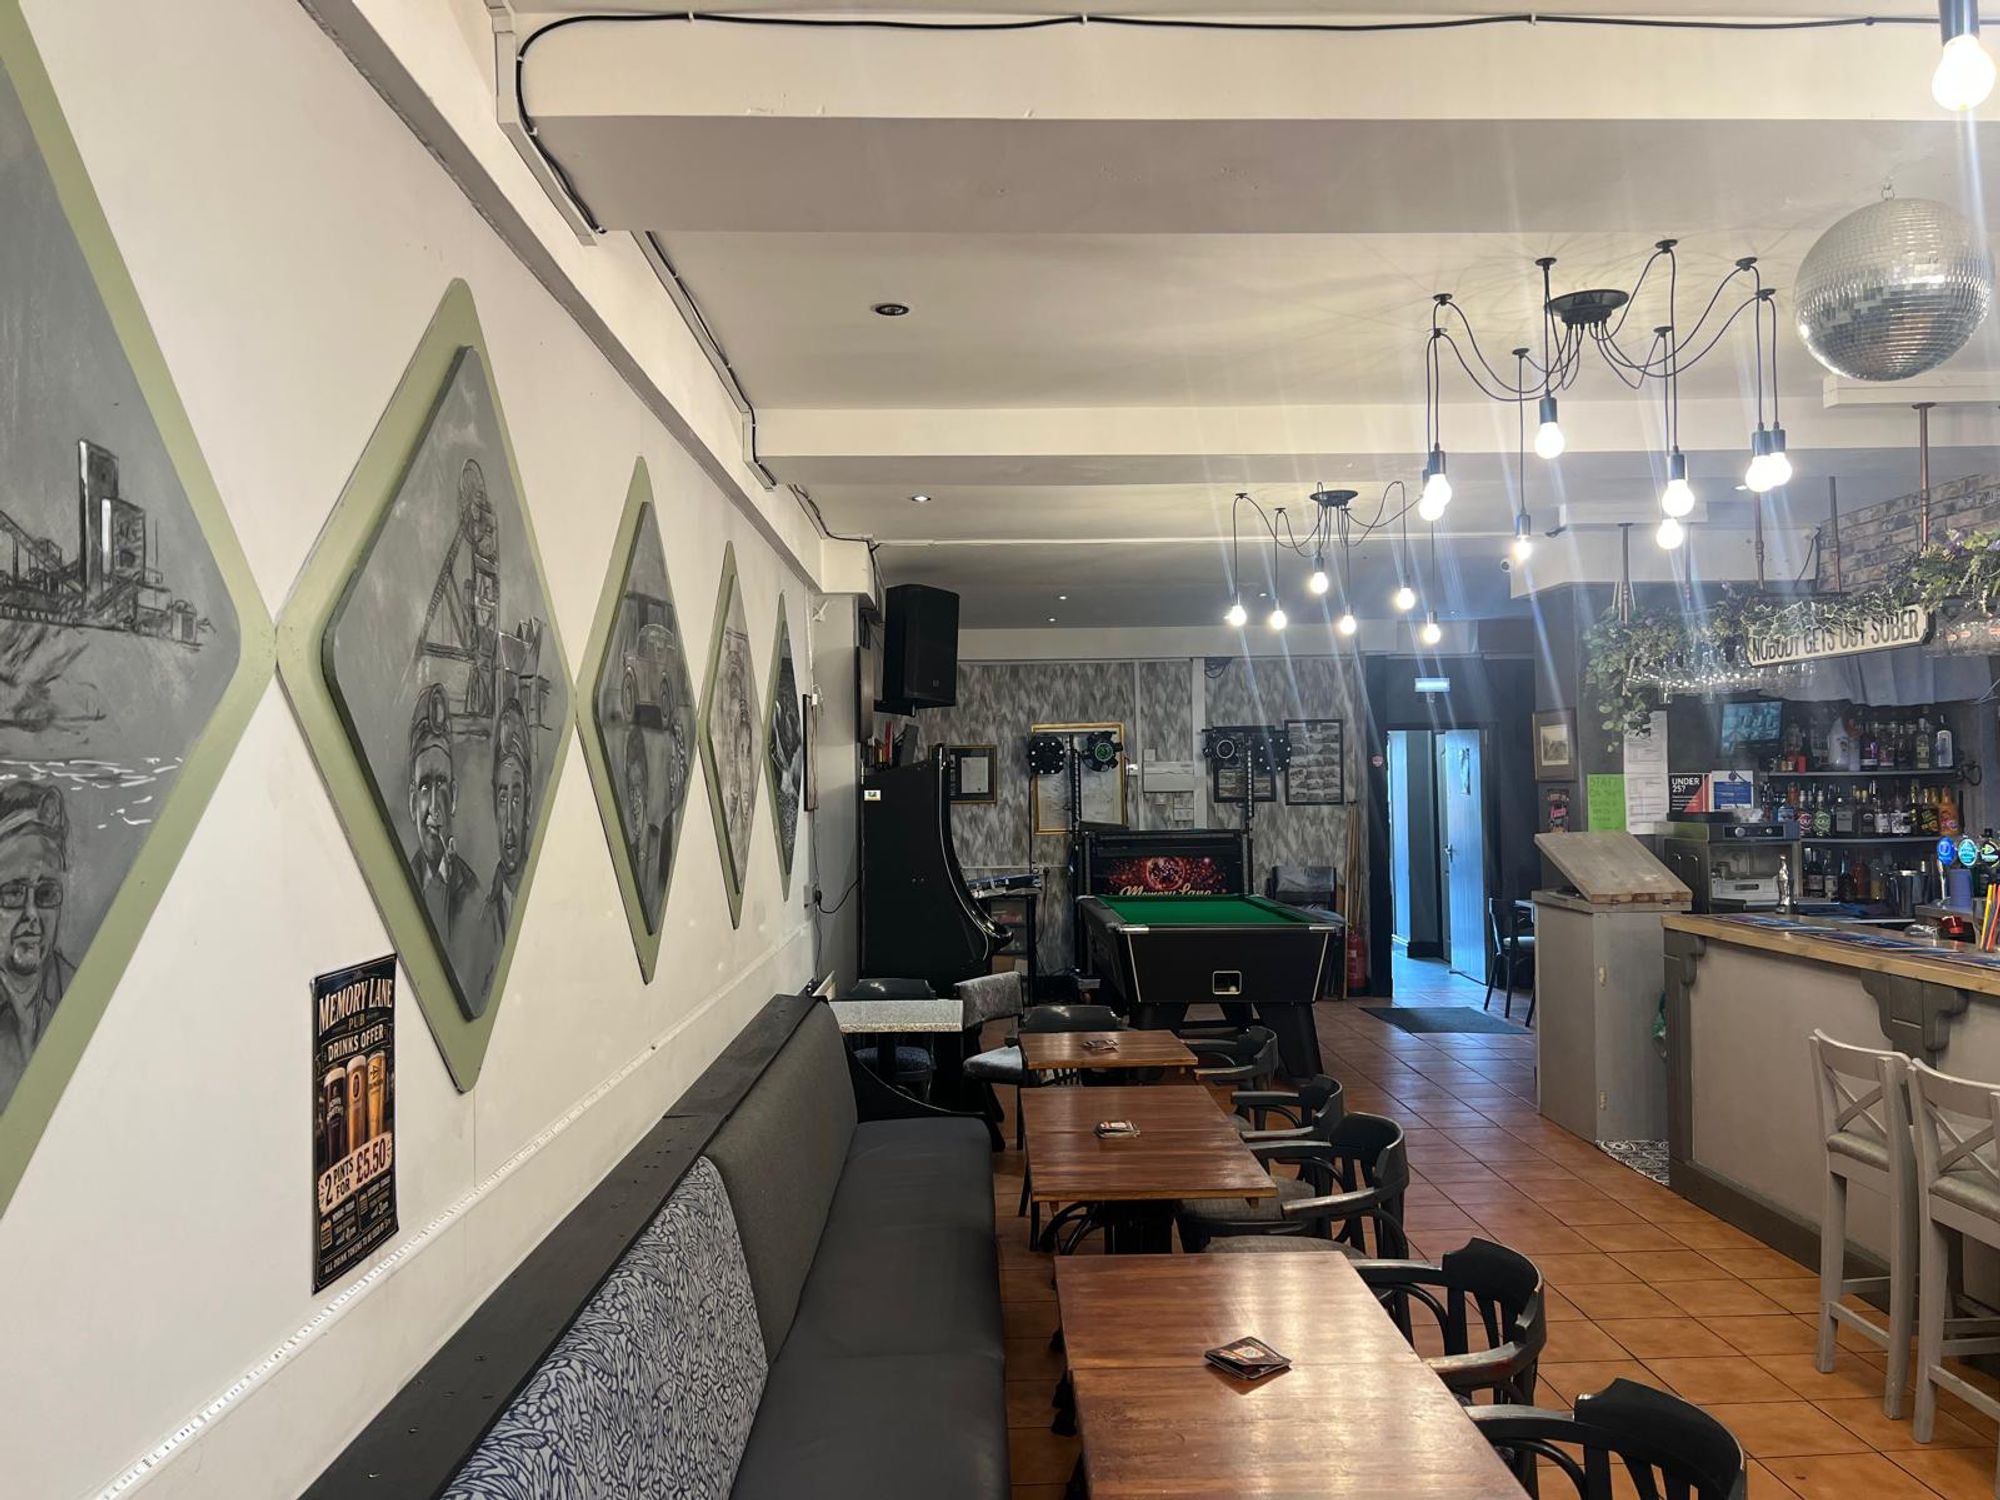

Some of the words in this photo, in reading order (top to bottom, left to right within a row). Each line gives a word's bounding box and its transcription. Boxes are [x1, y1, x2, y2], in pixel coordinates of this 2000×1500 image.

[1803, 626, 1836, 655] GETS
[1870, 608, 1919, 645] SOBER
[1671, 777, 1700, 785] UNDER
[1672, 785, 1686, 793] 25?
[318, 981, 368, 1037] MEMORY
[368, 977, 393, 1009] LANE
[348, 1013, 365, 1031] PUB
[328, 1034, 360, 1063] DRINKS
[361, 1024, 385, 1049] OFFER
[333, 1156, 354, 1186] PINTS
[356, 1137, 387, 1185] £5.50
[325, 1173, 334, 1207] 2
[336, 1177, 351, 1200] FOR
